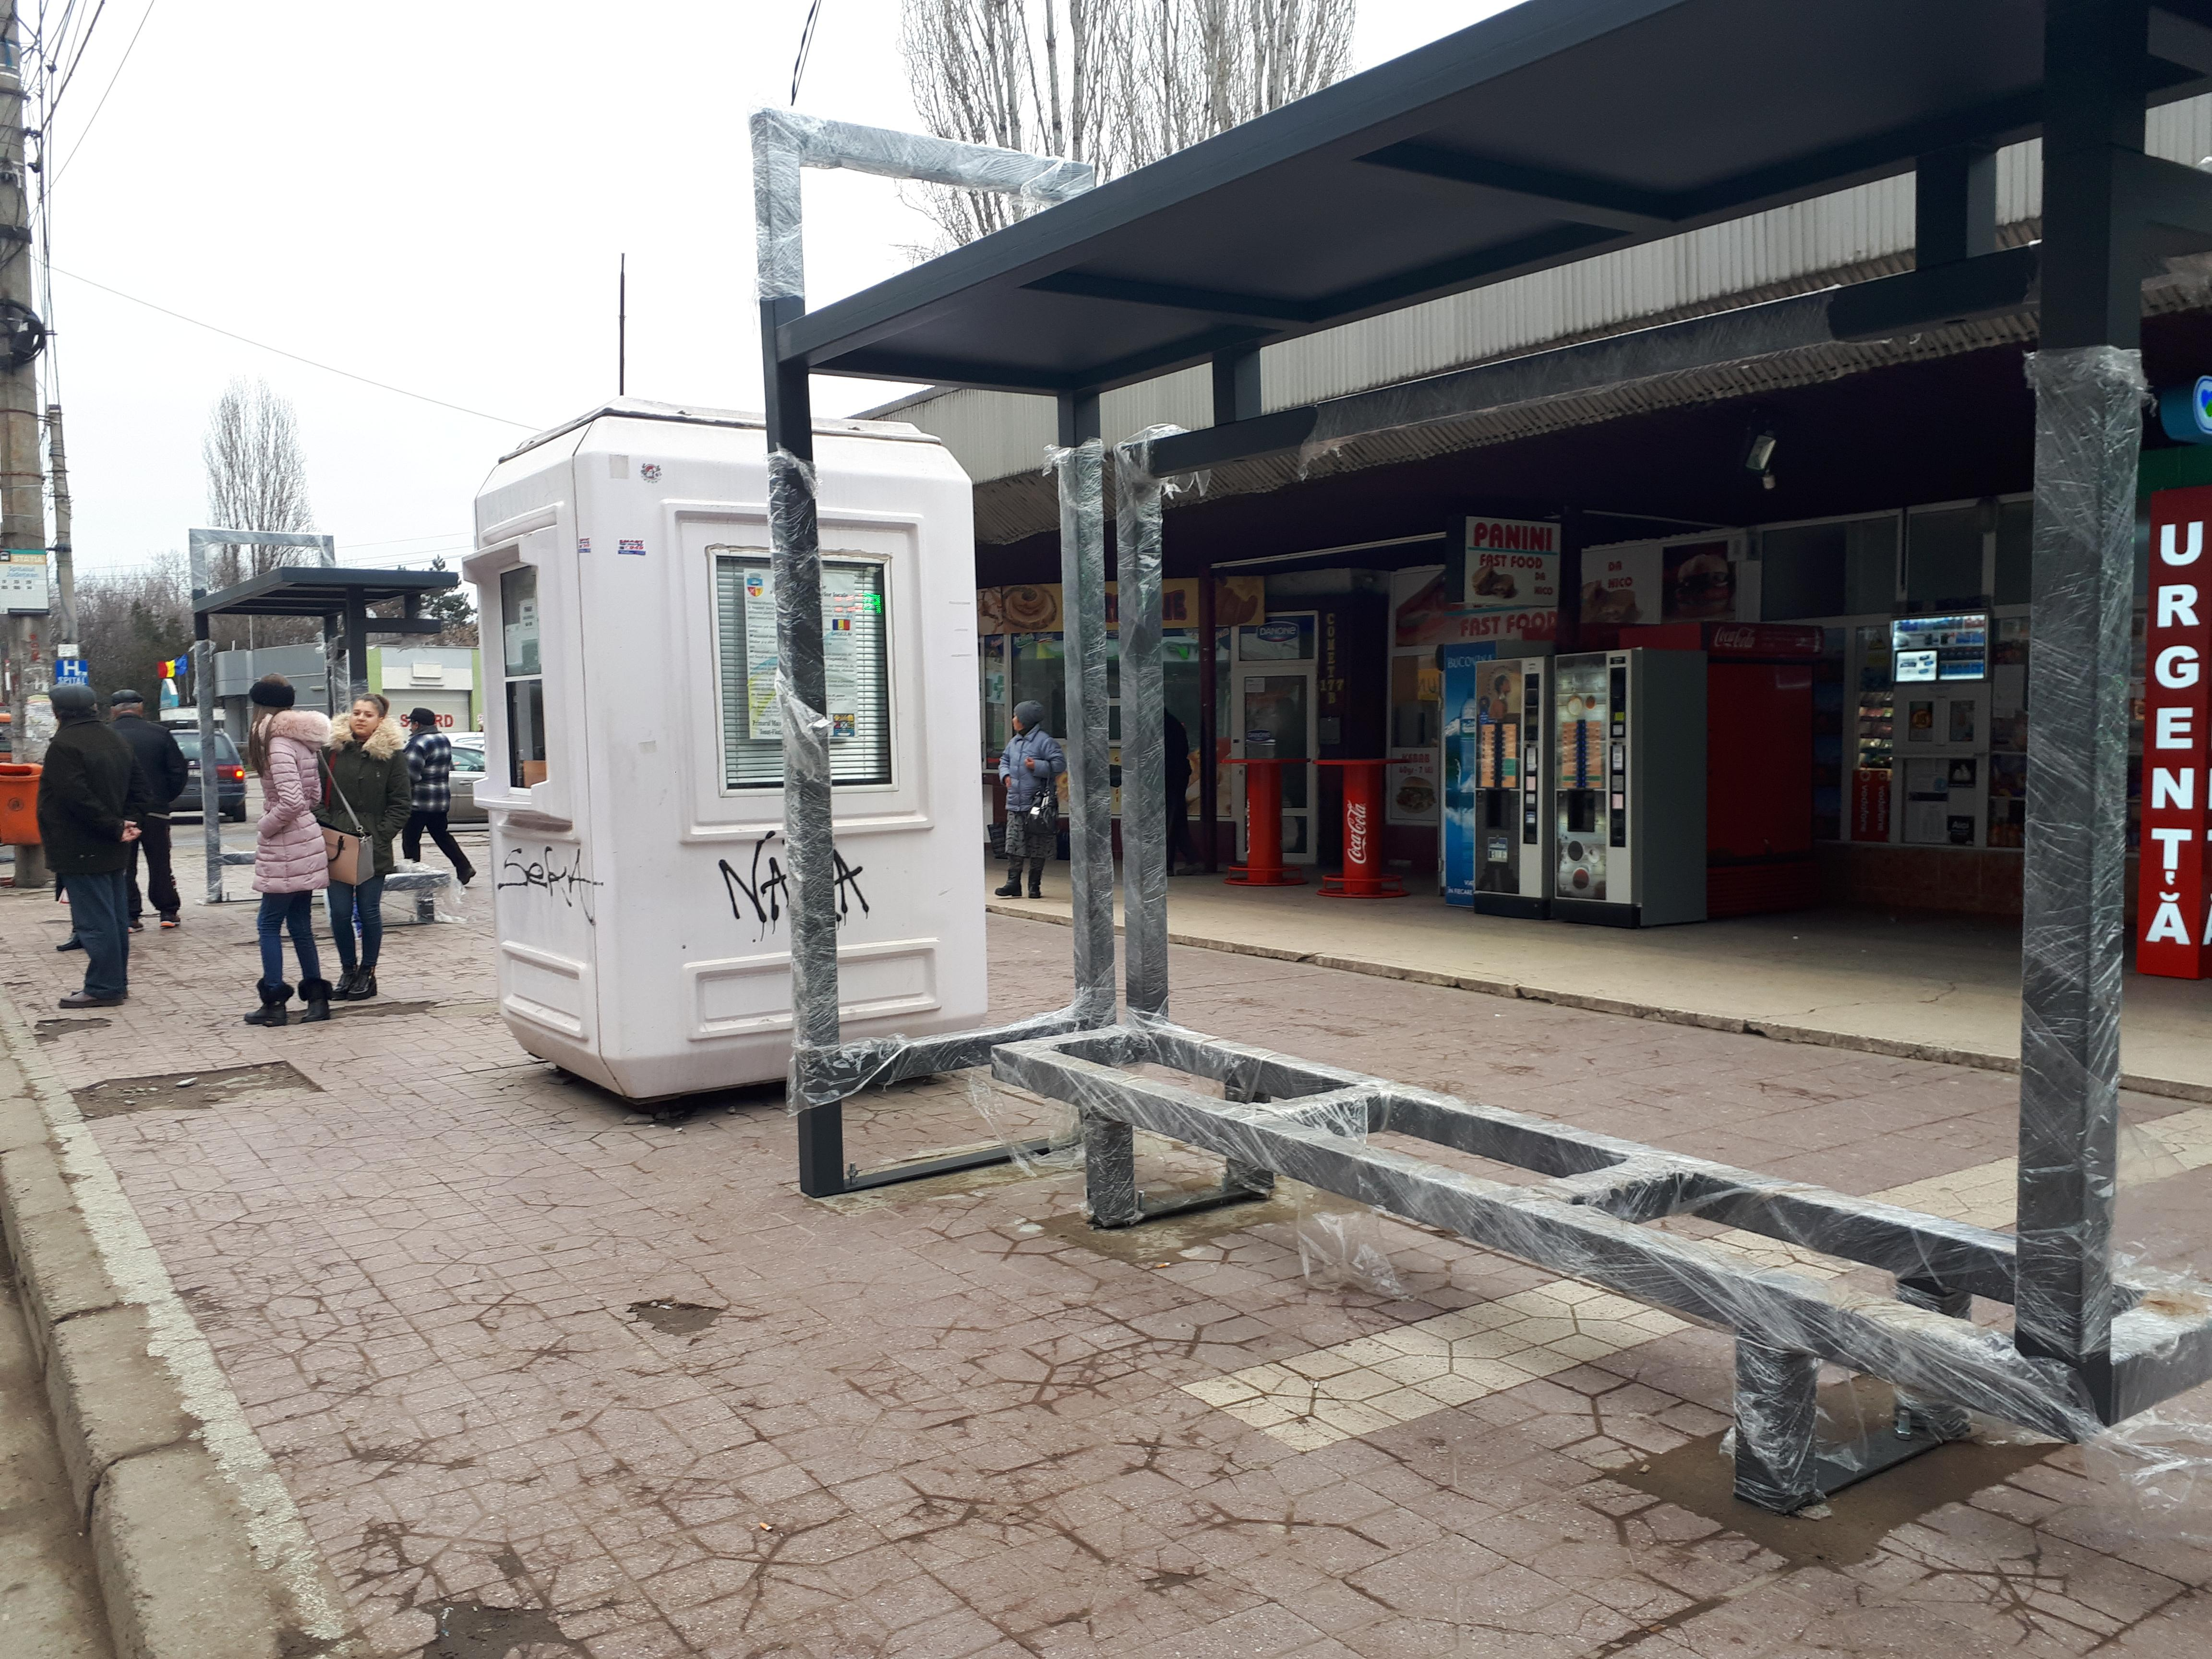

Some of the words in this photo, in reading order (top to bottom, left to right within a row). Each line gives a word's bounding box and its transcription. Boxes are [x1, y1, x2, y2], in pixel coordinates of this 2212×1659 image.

[1474, 522, 1552, 551] PANINI
[1480, 554, 1507, 567] FAST
[1510, 555, 1543, 569] FOOD
[1259, 626, 1297, 636] DANONE
[1460, 615, 1501, 637] FAST
[1321, 678, 1345, 692] 177
[2145, 520, 2204, 946] URGENȚĂ
